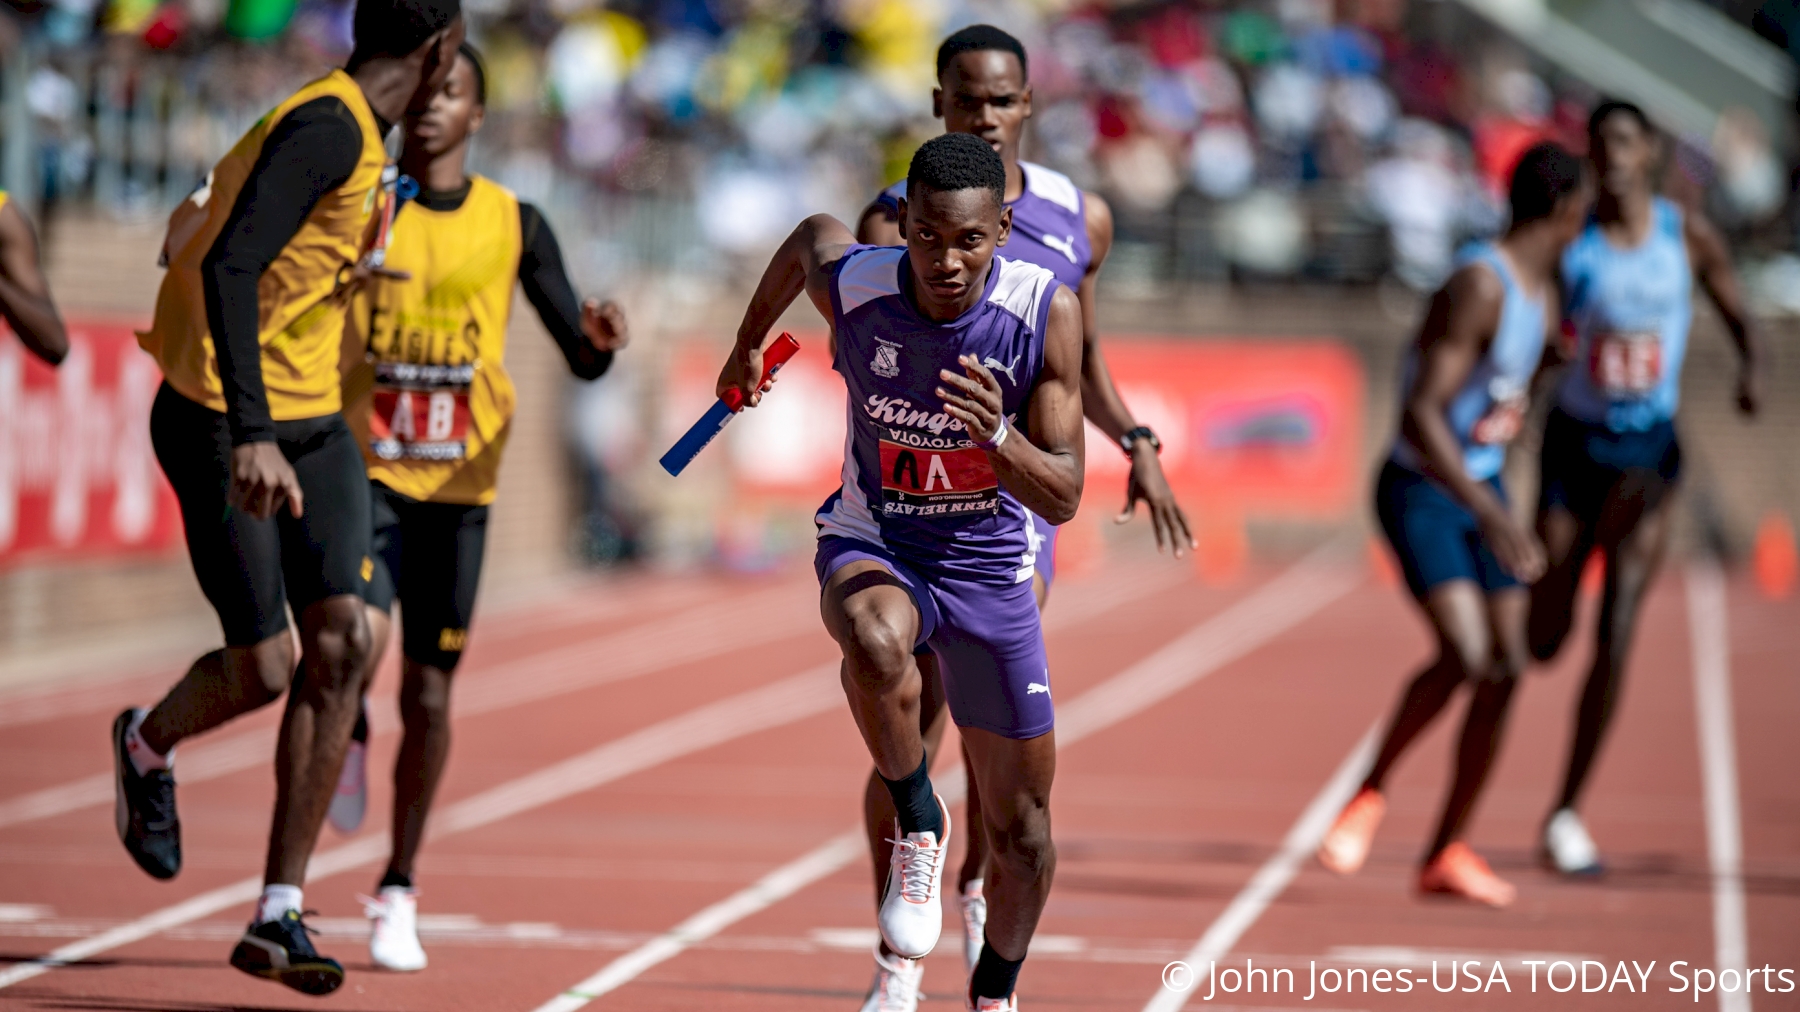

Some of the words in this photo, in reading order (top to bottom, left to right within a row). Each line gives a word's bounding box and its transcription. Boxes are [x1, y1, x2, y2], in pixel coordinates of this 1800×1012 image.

[889, 428, 955, 449] TOYOTA
[928, 493, 983, 501] ON-RUNNING.COM
[884, 501, 950, 516] RELAYS
[949, 498, 998, 512] PENN
